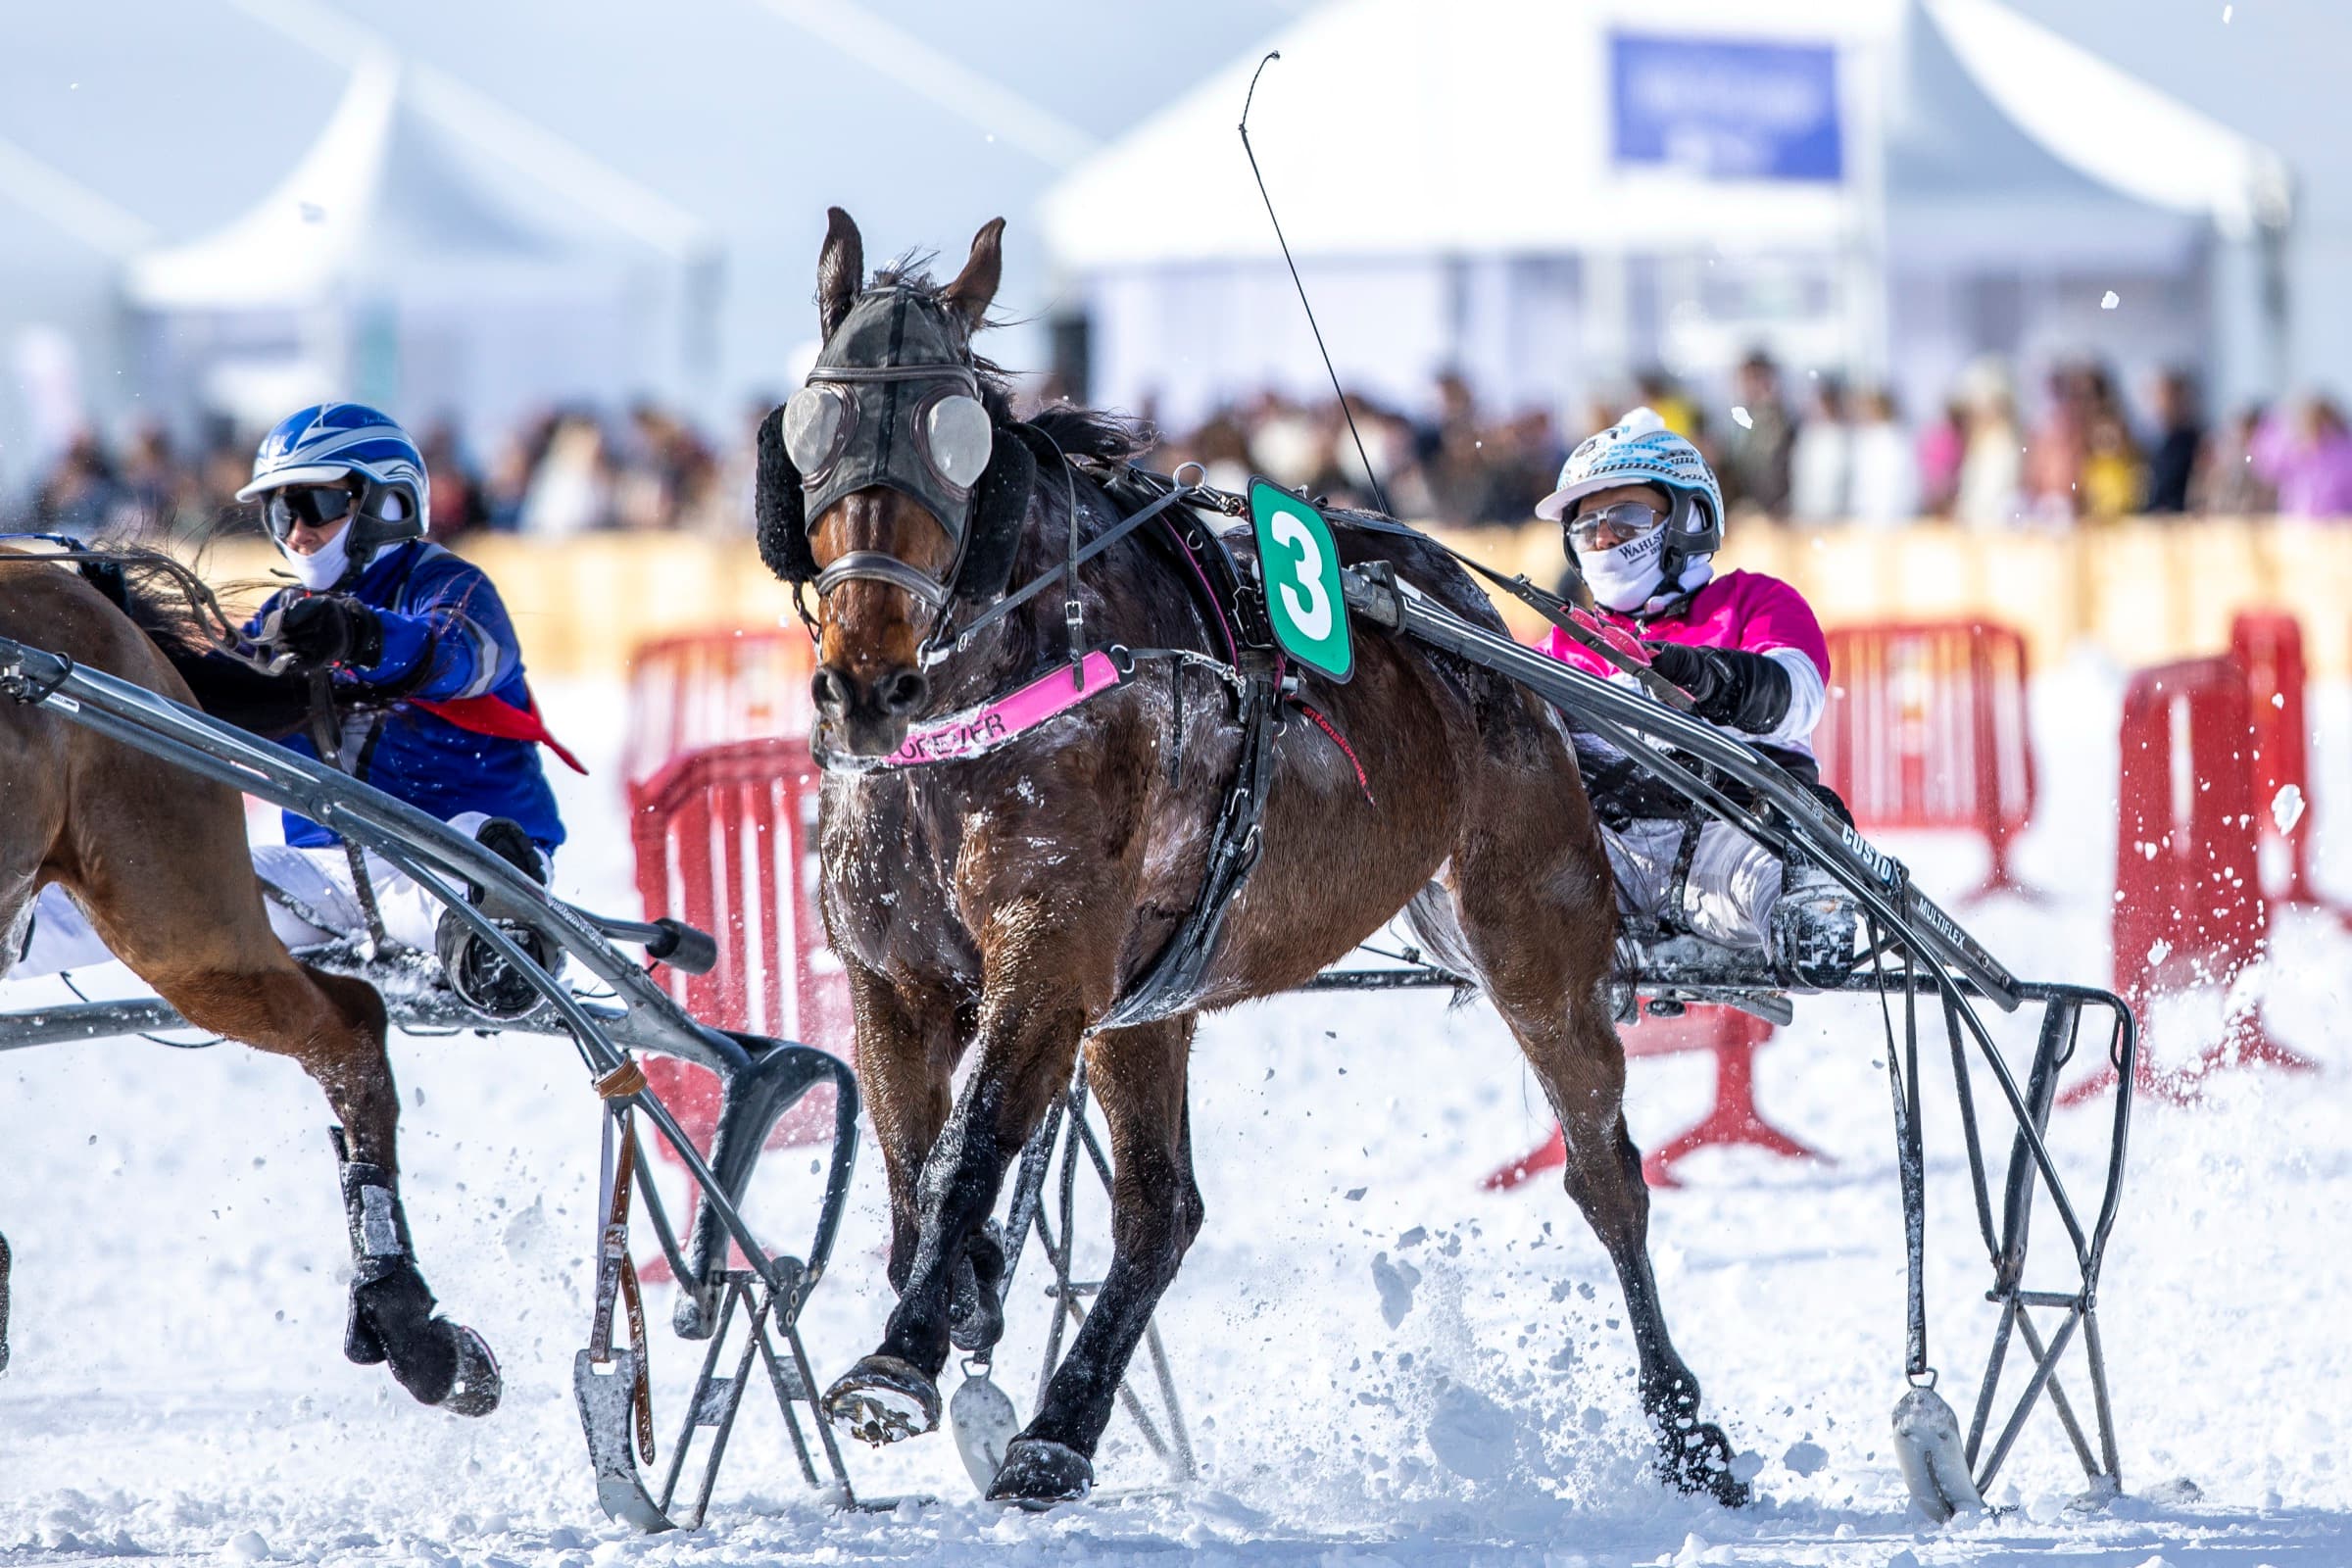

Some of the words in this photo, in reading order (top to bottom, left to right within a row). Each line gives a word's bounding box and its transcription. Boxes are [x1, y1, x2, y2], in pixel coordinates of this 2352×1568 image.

[1618, 527, 1667, 560] WAHLST
[1271, 511, 1333, 642] 3
[1841, 822, 1896, 883] CUSTO
[1917, 897, 1966, 951] MULTIFLEX
